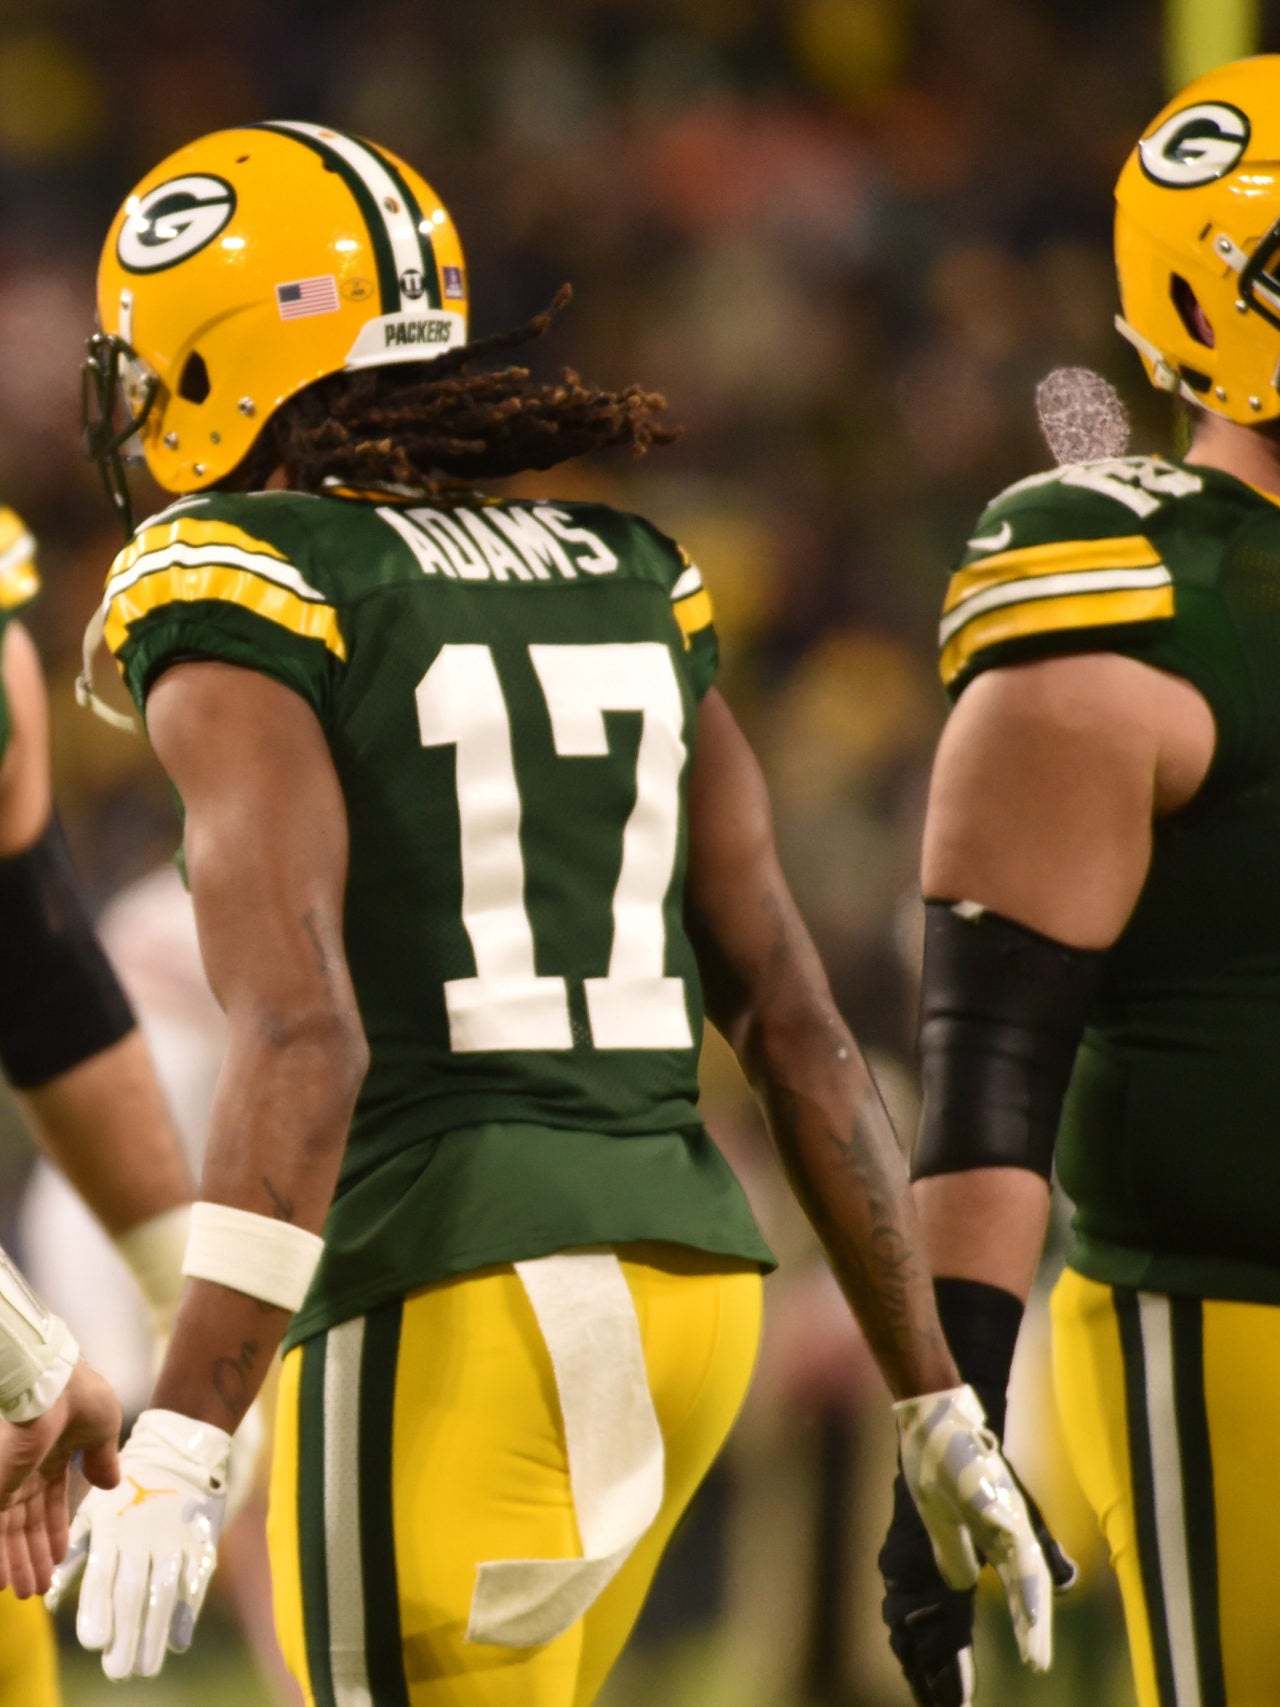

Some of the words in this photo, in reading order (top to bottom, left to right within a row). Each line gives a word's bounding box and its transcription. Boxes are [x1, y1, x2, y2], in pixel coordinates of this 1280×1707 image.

[118, 175, 233, 270] G
[384, 319, 452, 347] PACKERS
[375, 506, 619, 582] ADAMS
[414, 642, 694, 1053] 17
